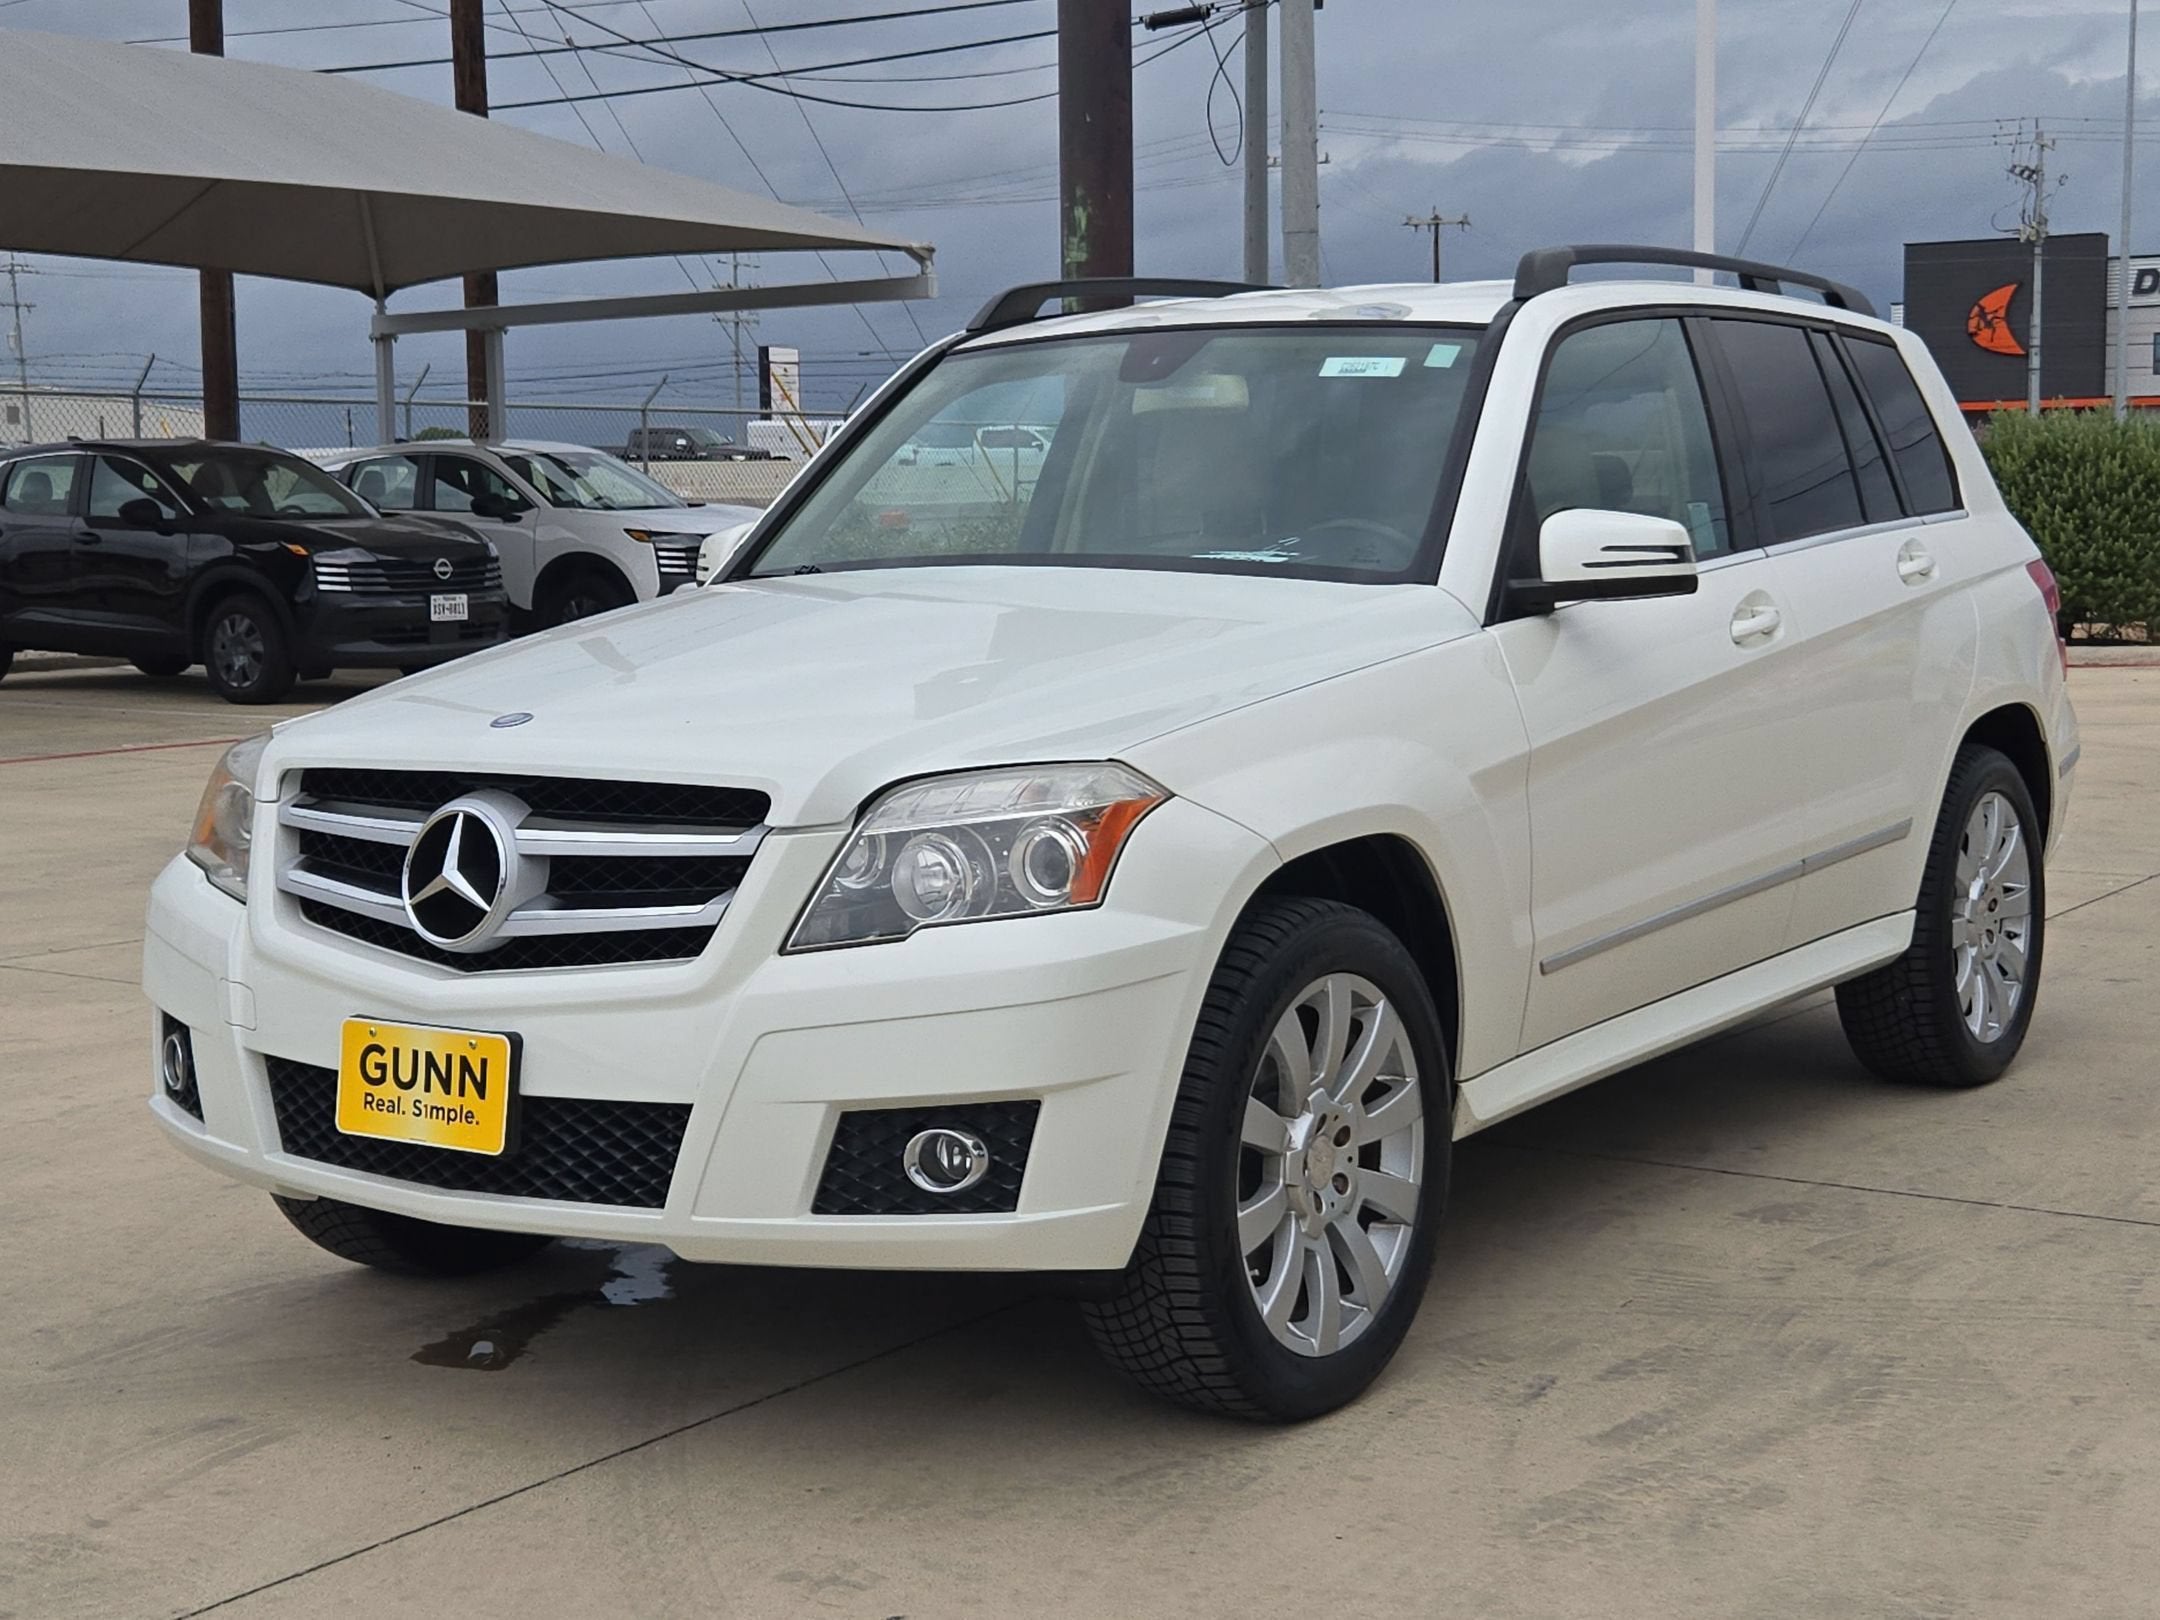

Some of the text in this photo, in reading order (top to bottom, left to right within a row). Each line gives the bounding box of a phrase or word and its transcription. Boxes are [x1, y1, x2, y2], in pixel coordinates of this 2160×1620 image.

[2132, 269, 2160, 296] D
[360, 1043, 488, 1101] GUNN
[363, 1092, 406, 1115] Real.
